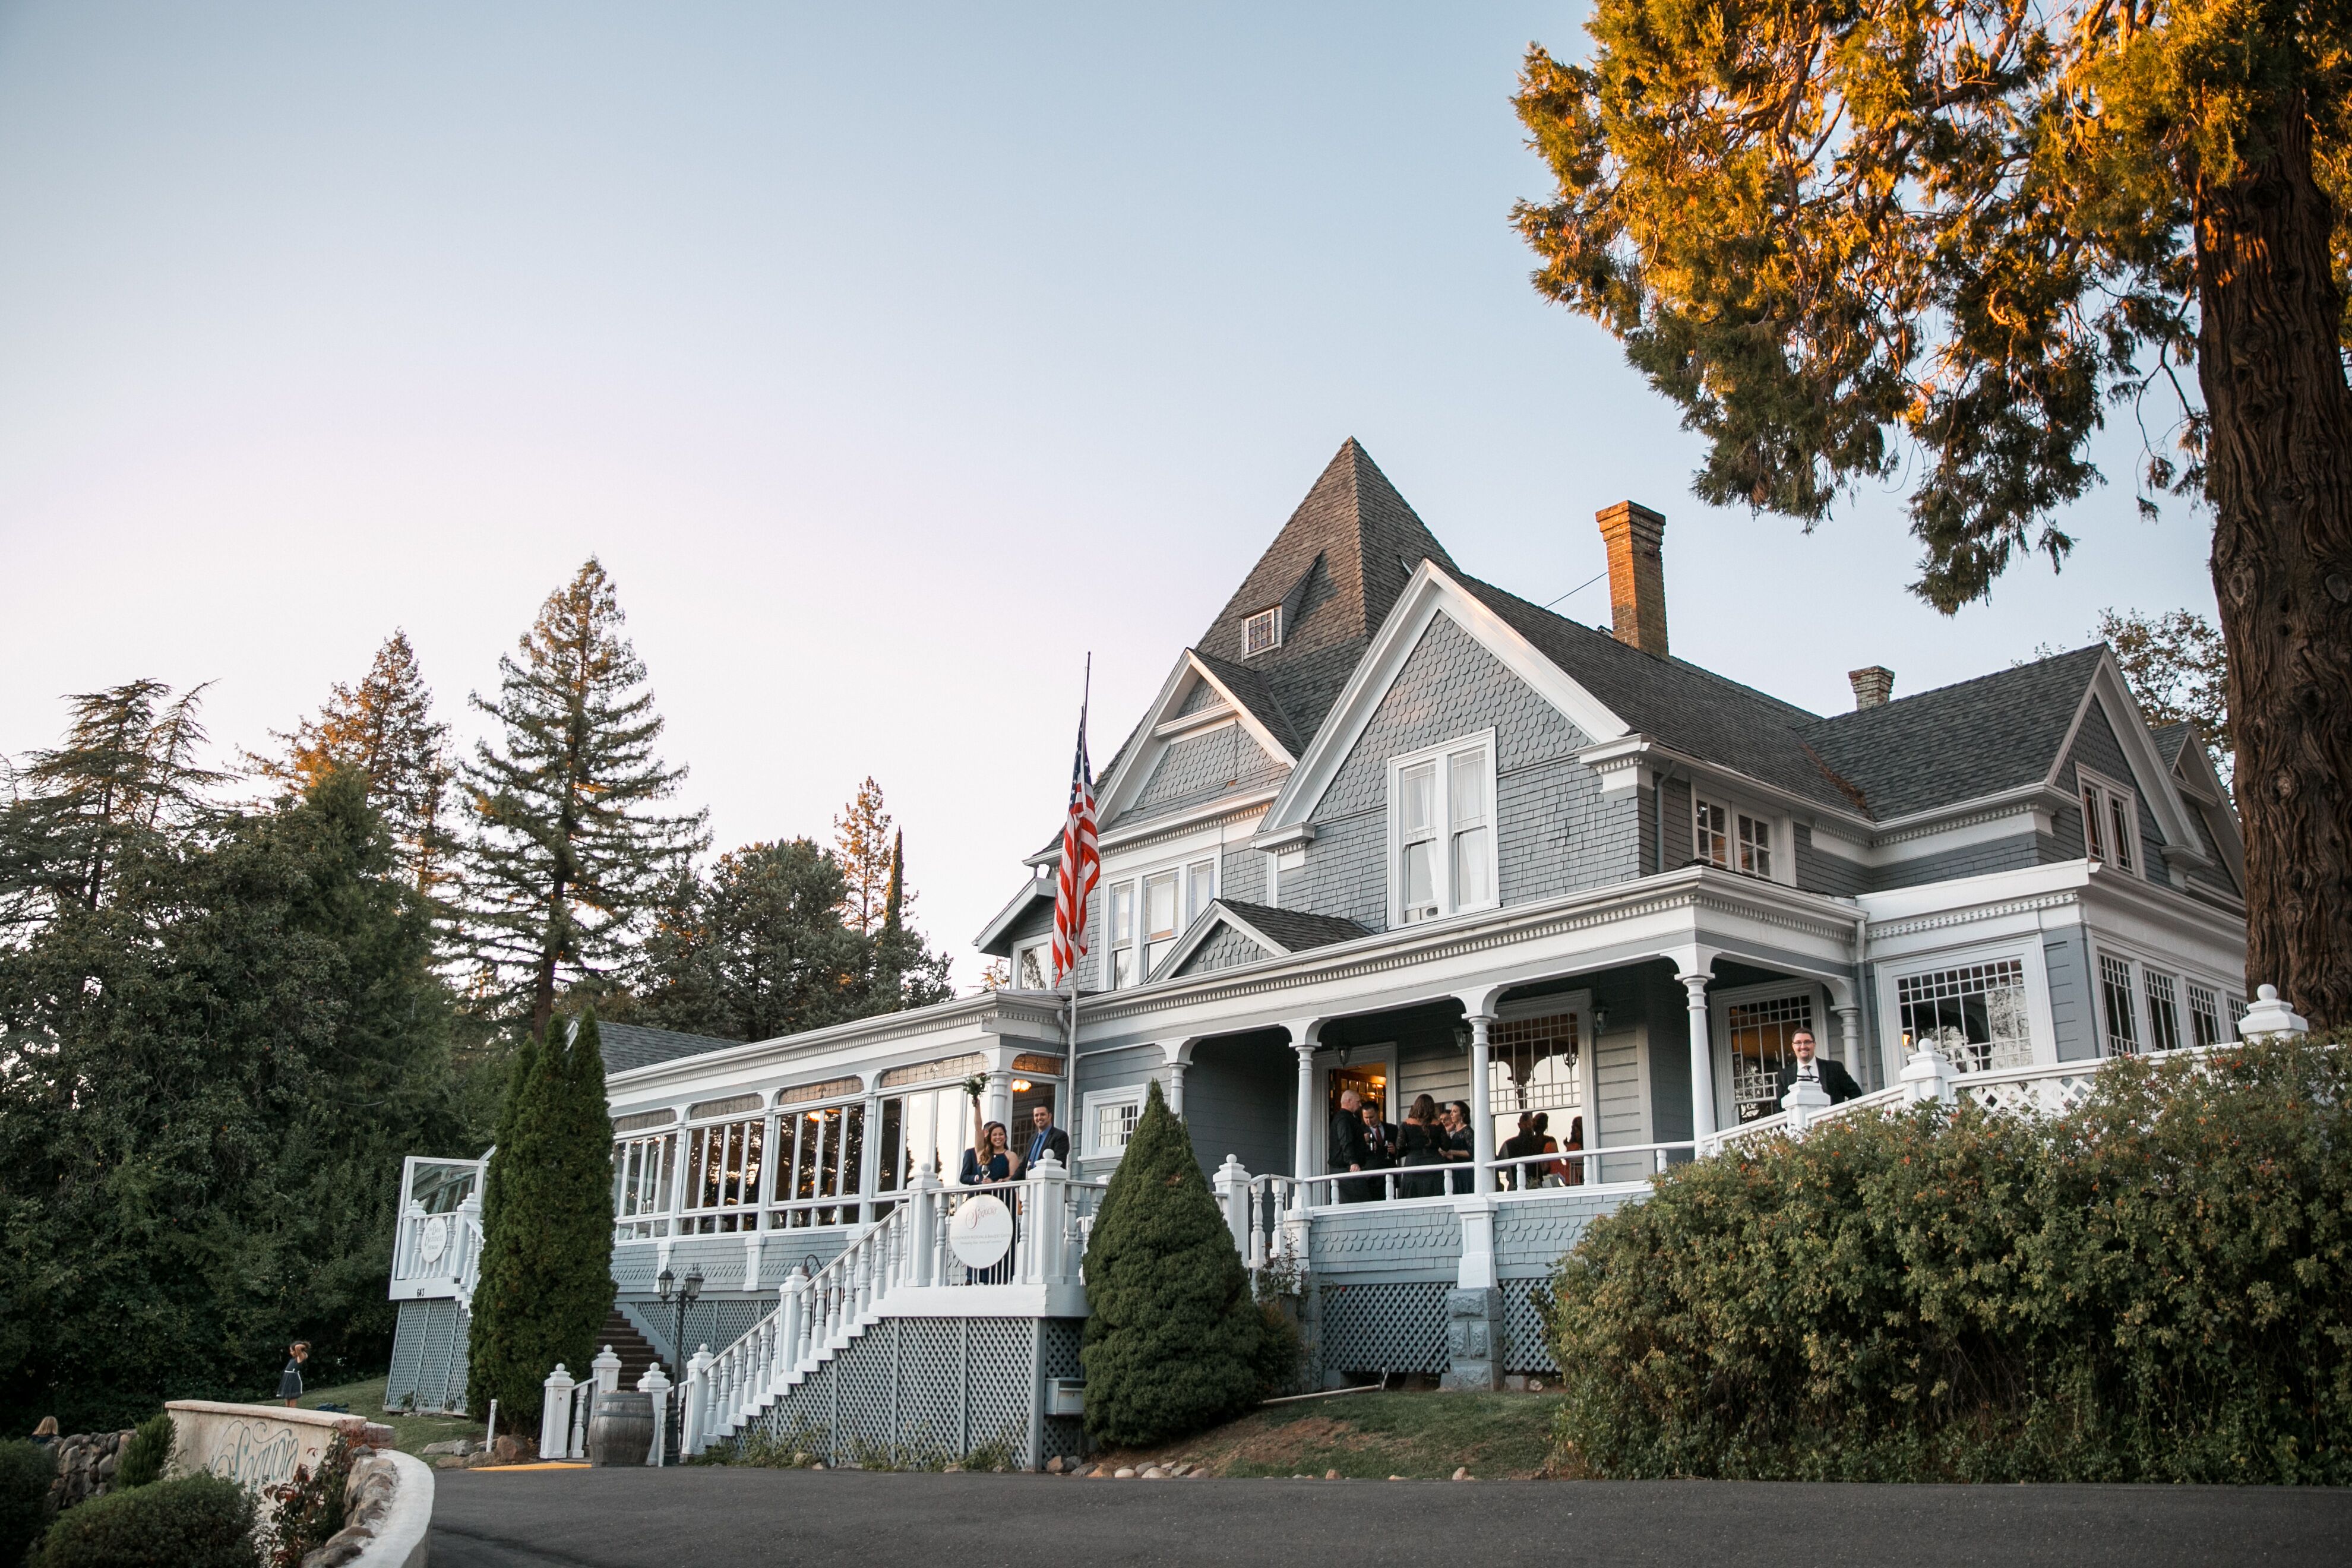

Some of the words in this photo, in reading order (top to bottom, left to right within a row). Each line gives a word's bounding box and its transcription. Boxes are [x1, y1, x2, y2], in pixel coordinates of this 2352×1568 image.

[966, 1206, 997, 1230] Sequoia
[425, 1233, 443, 1246] Bennett
[210, 1420, 299, 1493] Sequoia
